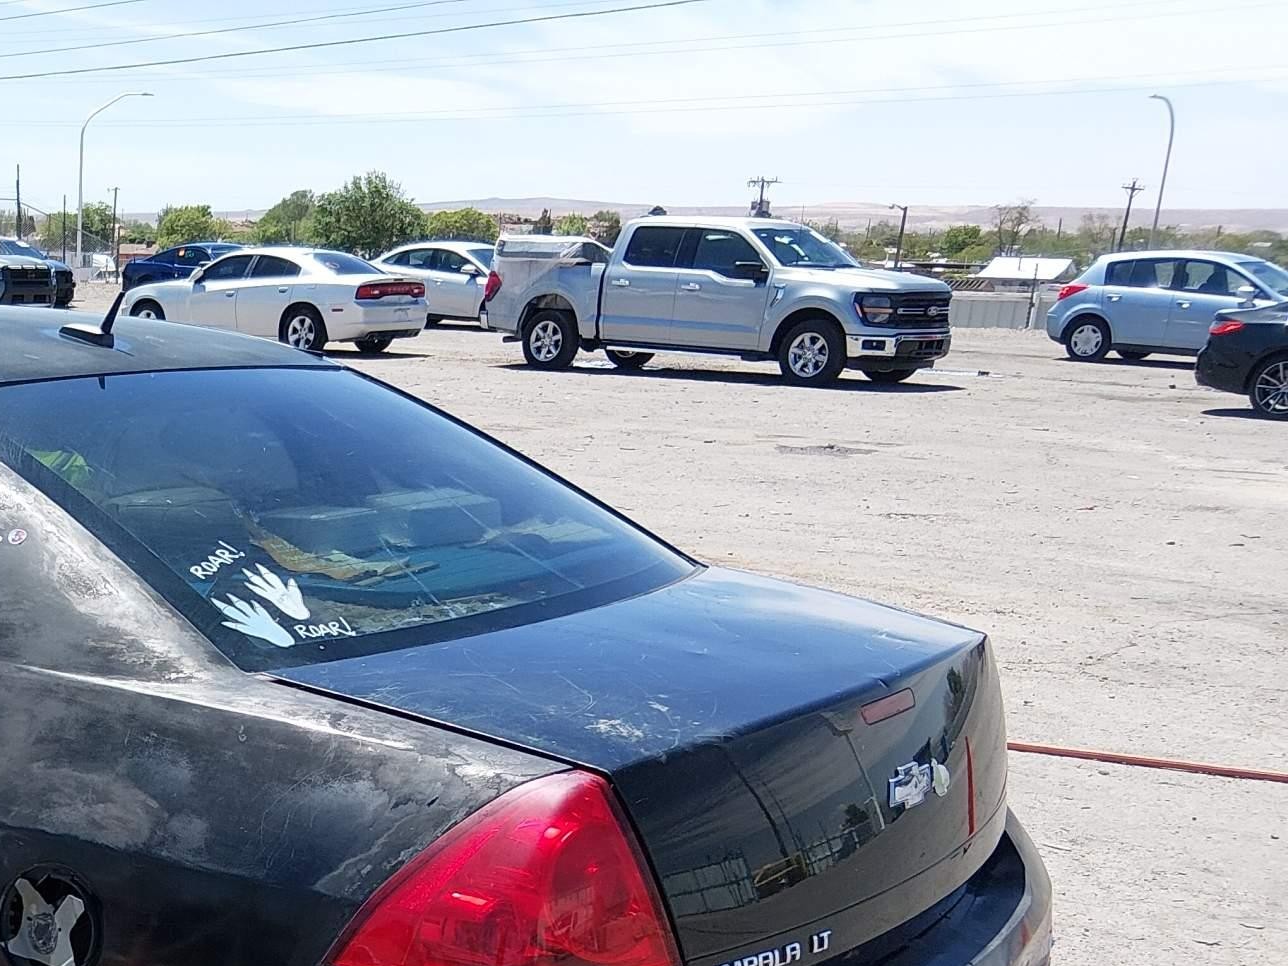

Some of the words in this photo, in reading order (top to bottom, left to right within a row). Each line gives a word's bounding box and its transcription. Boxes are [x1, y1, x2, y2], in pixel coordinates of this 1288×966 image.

[189, 539, 246, 580] ROAR!
[293, 616, 357, 639] ROAR!
[811, 930, 832, 954] LT
